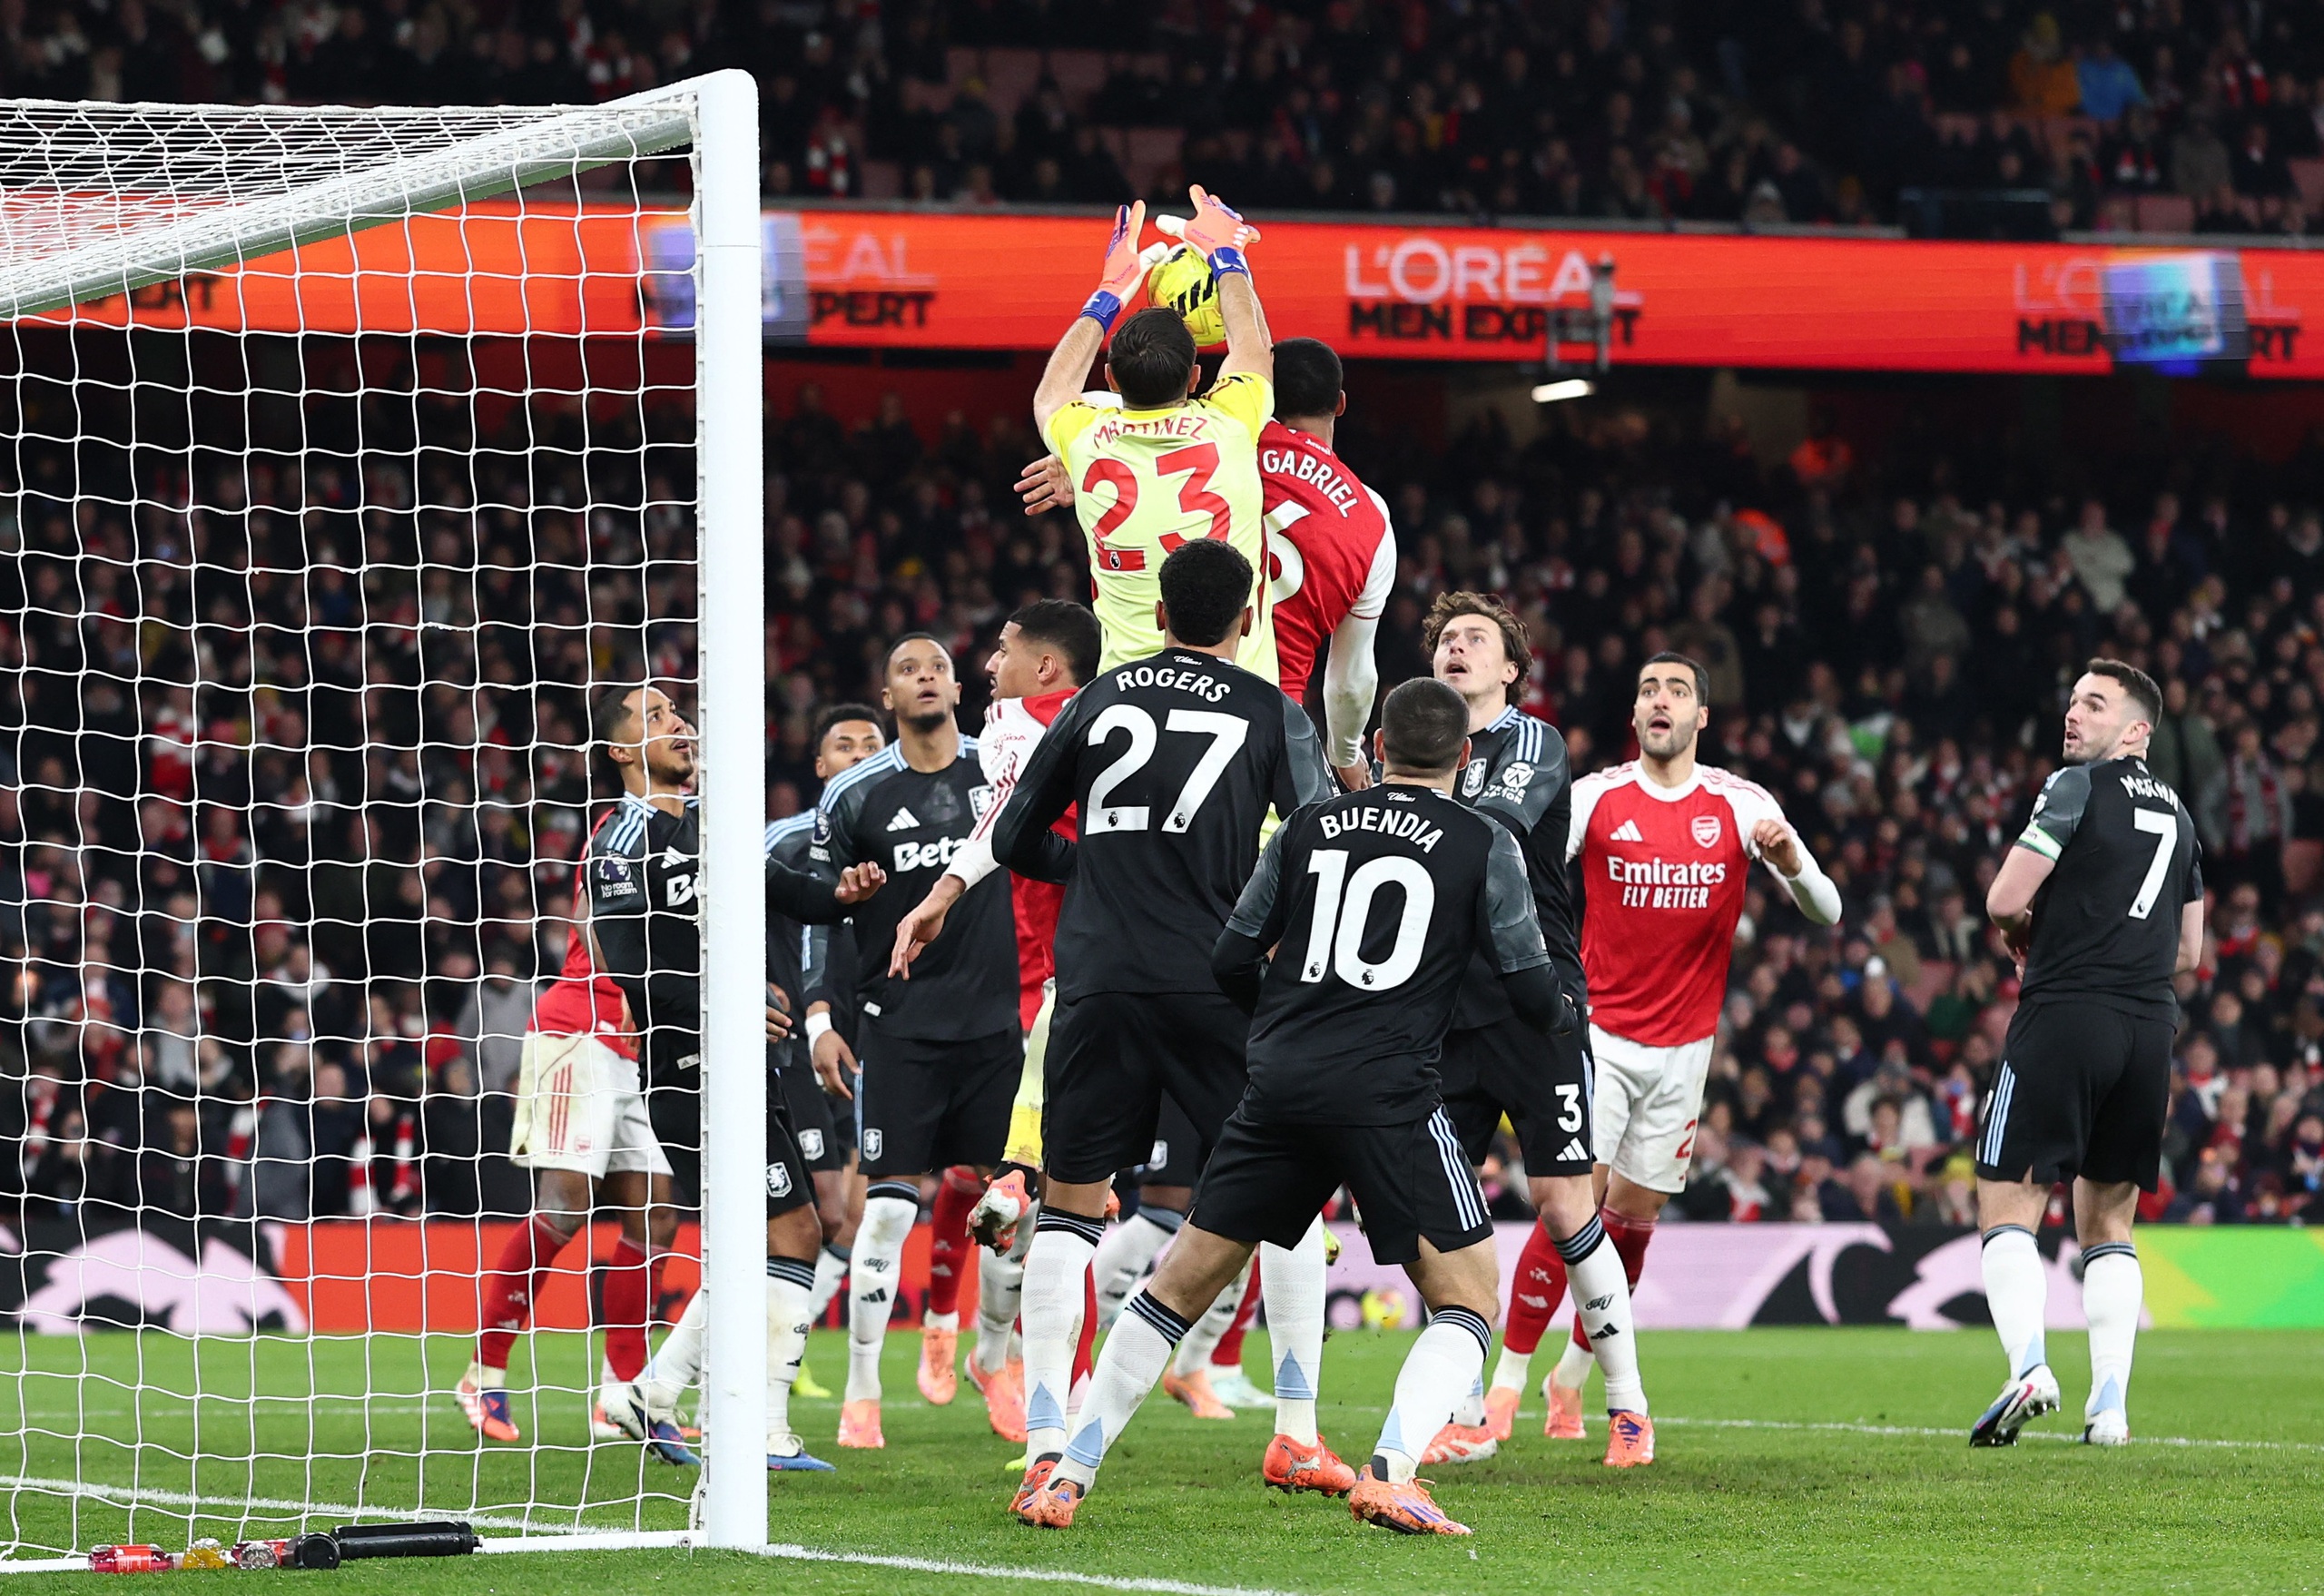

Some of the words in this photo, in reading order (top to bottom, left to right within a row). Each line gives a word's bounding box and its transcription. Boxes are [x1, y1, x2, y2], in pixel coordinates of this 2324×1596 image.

[1350, 301, 1450, 341] MEN
[1094, 417, 1207, 448] MARTINEZ
[1082, 442, 1231, 571] 23
[1263, 450, 1359, 518] GABRIEL
[1263, 499, 1311, 606] 6
[1116, 666, 1231, 703] ROGERS
[1085, 704, 1249, 835] 27
[1319, 806, 1444, 853] BUENDIA
[601, 883, 612, 892] No
[613, 882, 634, 891] room
[1607, 855, 1727, 885] Emirates
[2128, 807, 2178, 920] 7
[1300, 849, 1435, 991] 10
[1622, 886, 1649, 908] FLY
[1652, 886, 1709, 908] BETTER
[1555, 1083, 1582, 1133] 3
